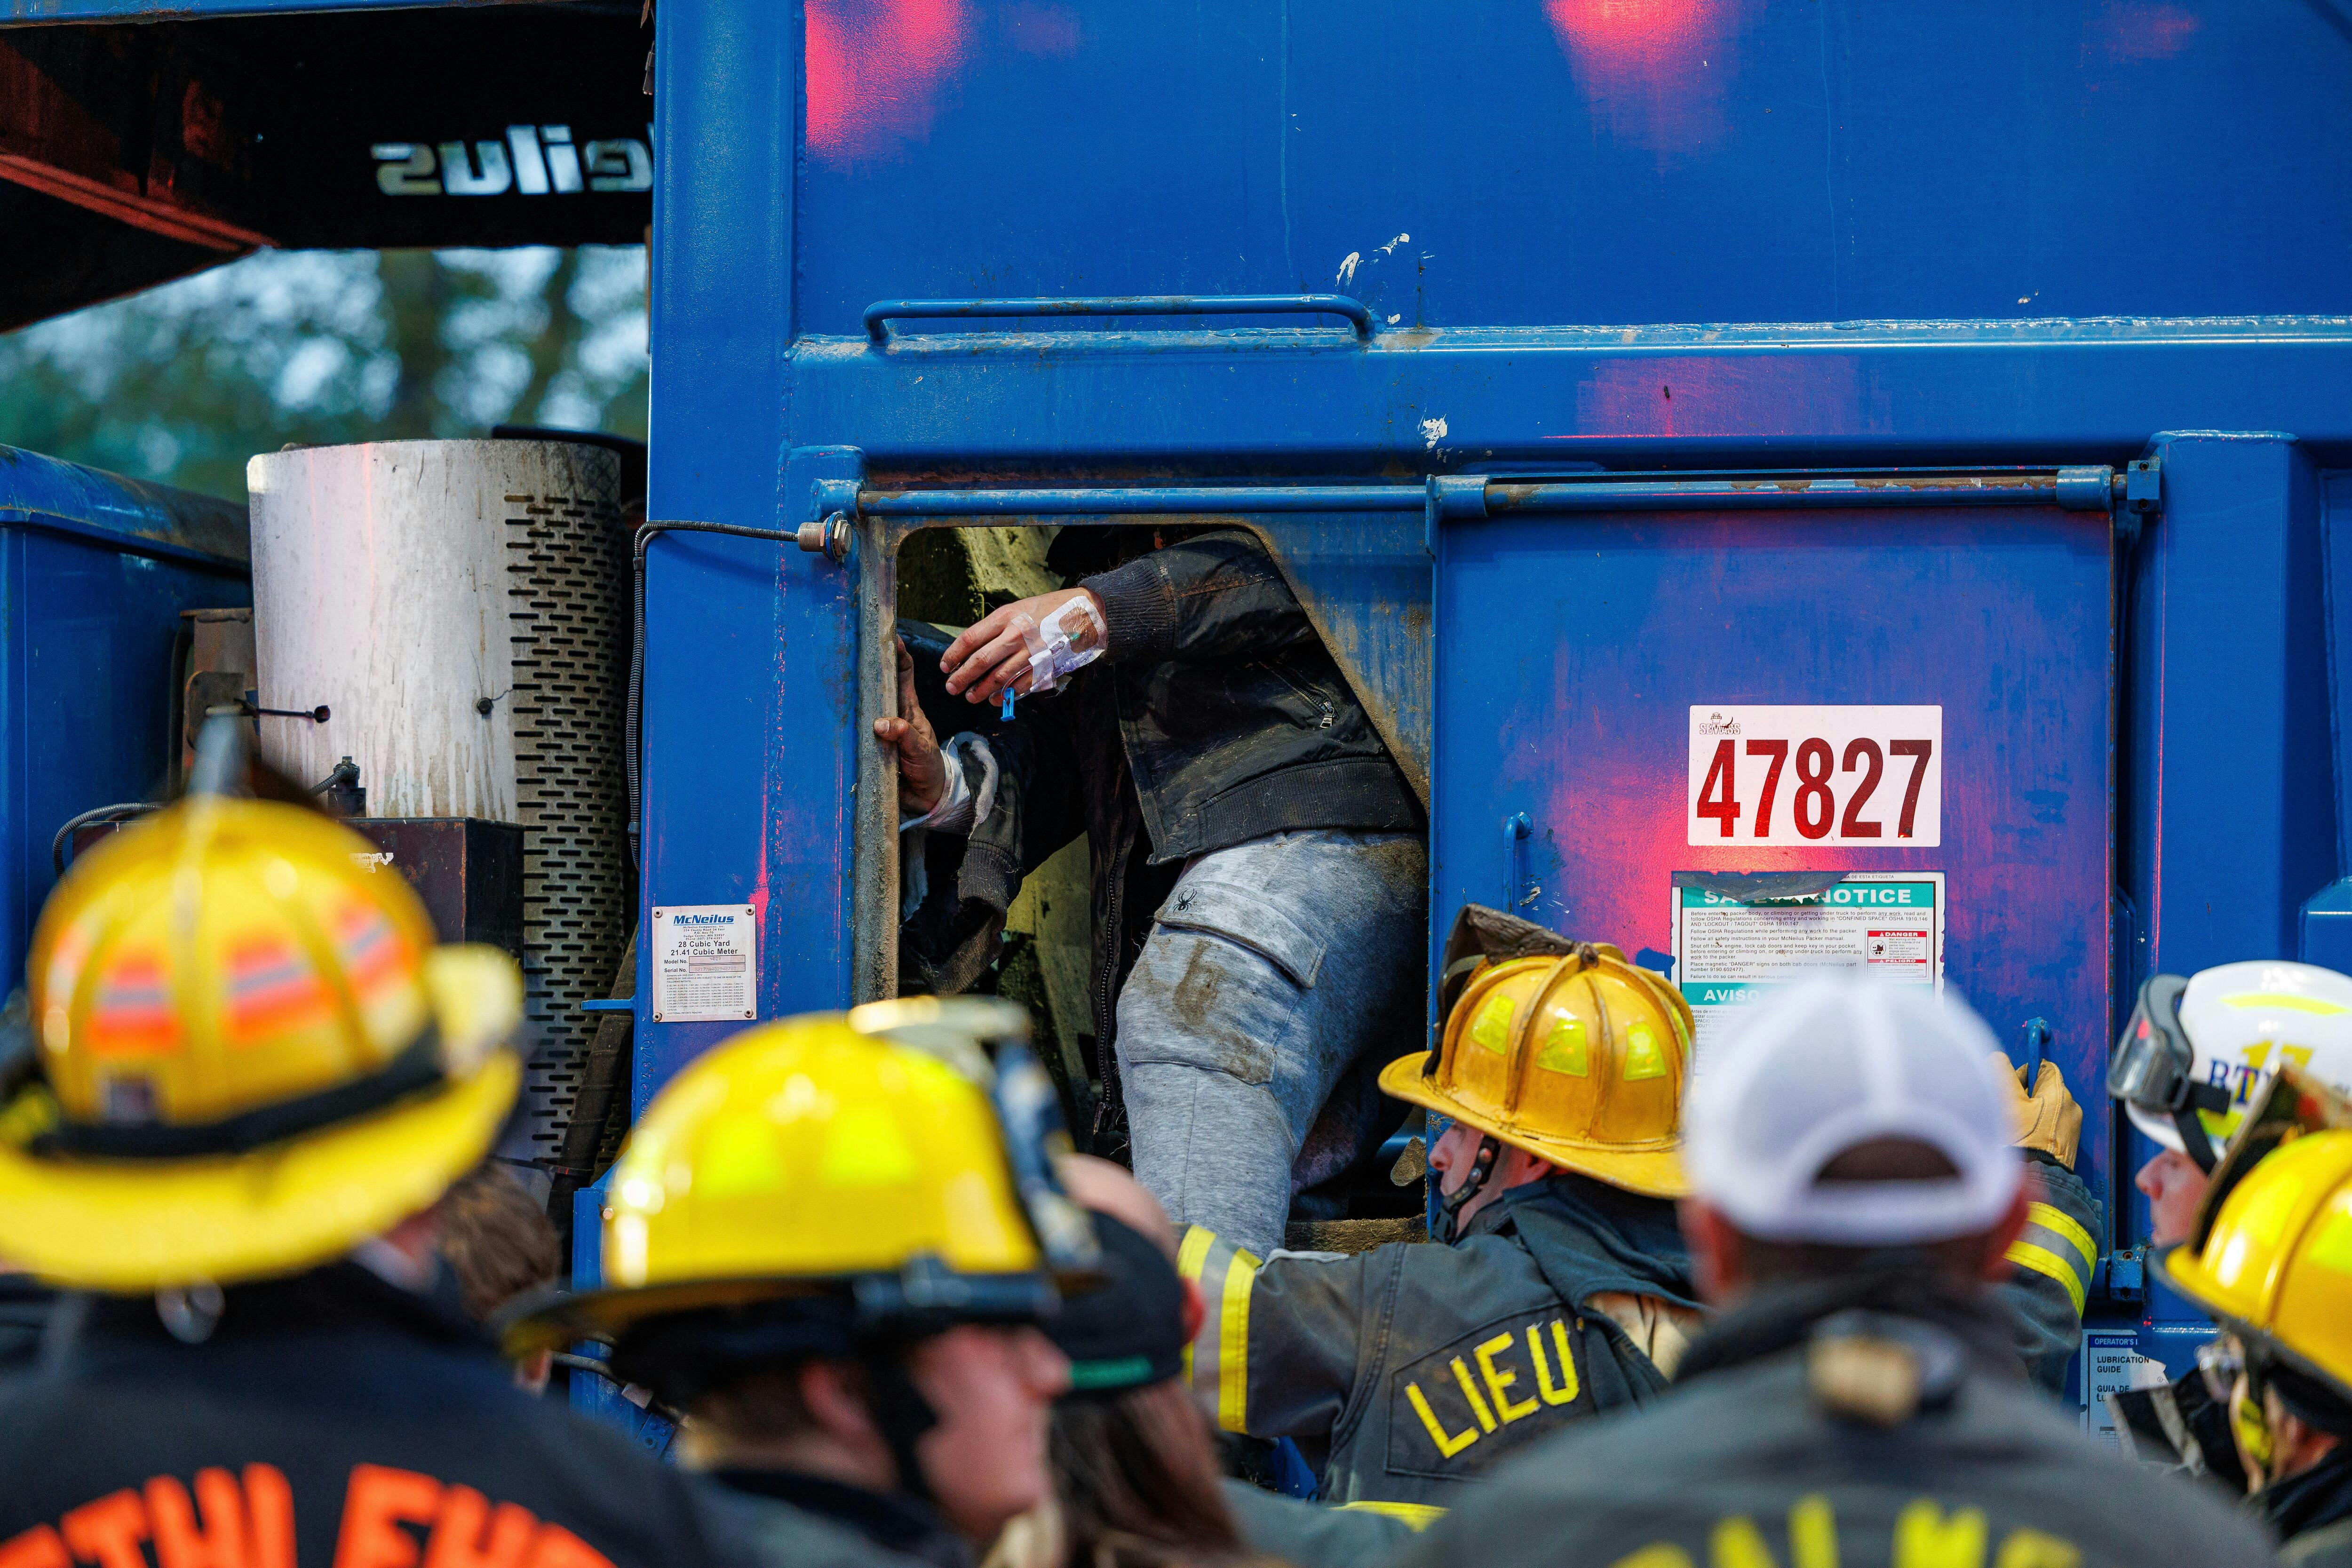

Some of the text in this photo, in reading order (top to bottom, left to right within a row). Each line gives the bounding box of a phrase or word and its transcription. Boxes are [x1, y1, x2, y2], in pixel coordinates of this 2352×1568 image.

[1697, 737, 1932, 839] 47827
[674, 915, 734, 924] McNeilus
[1703, 989, 1760, 1001] AVISO
[1405, 1318, 1580, 1458] LIEU
